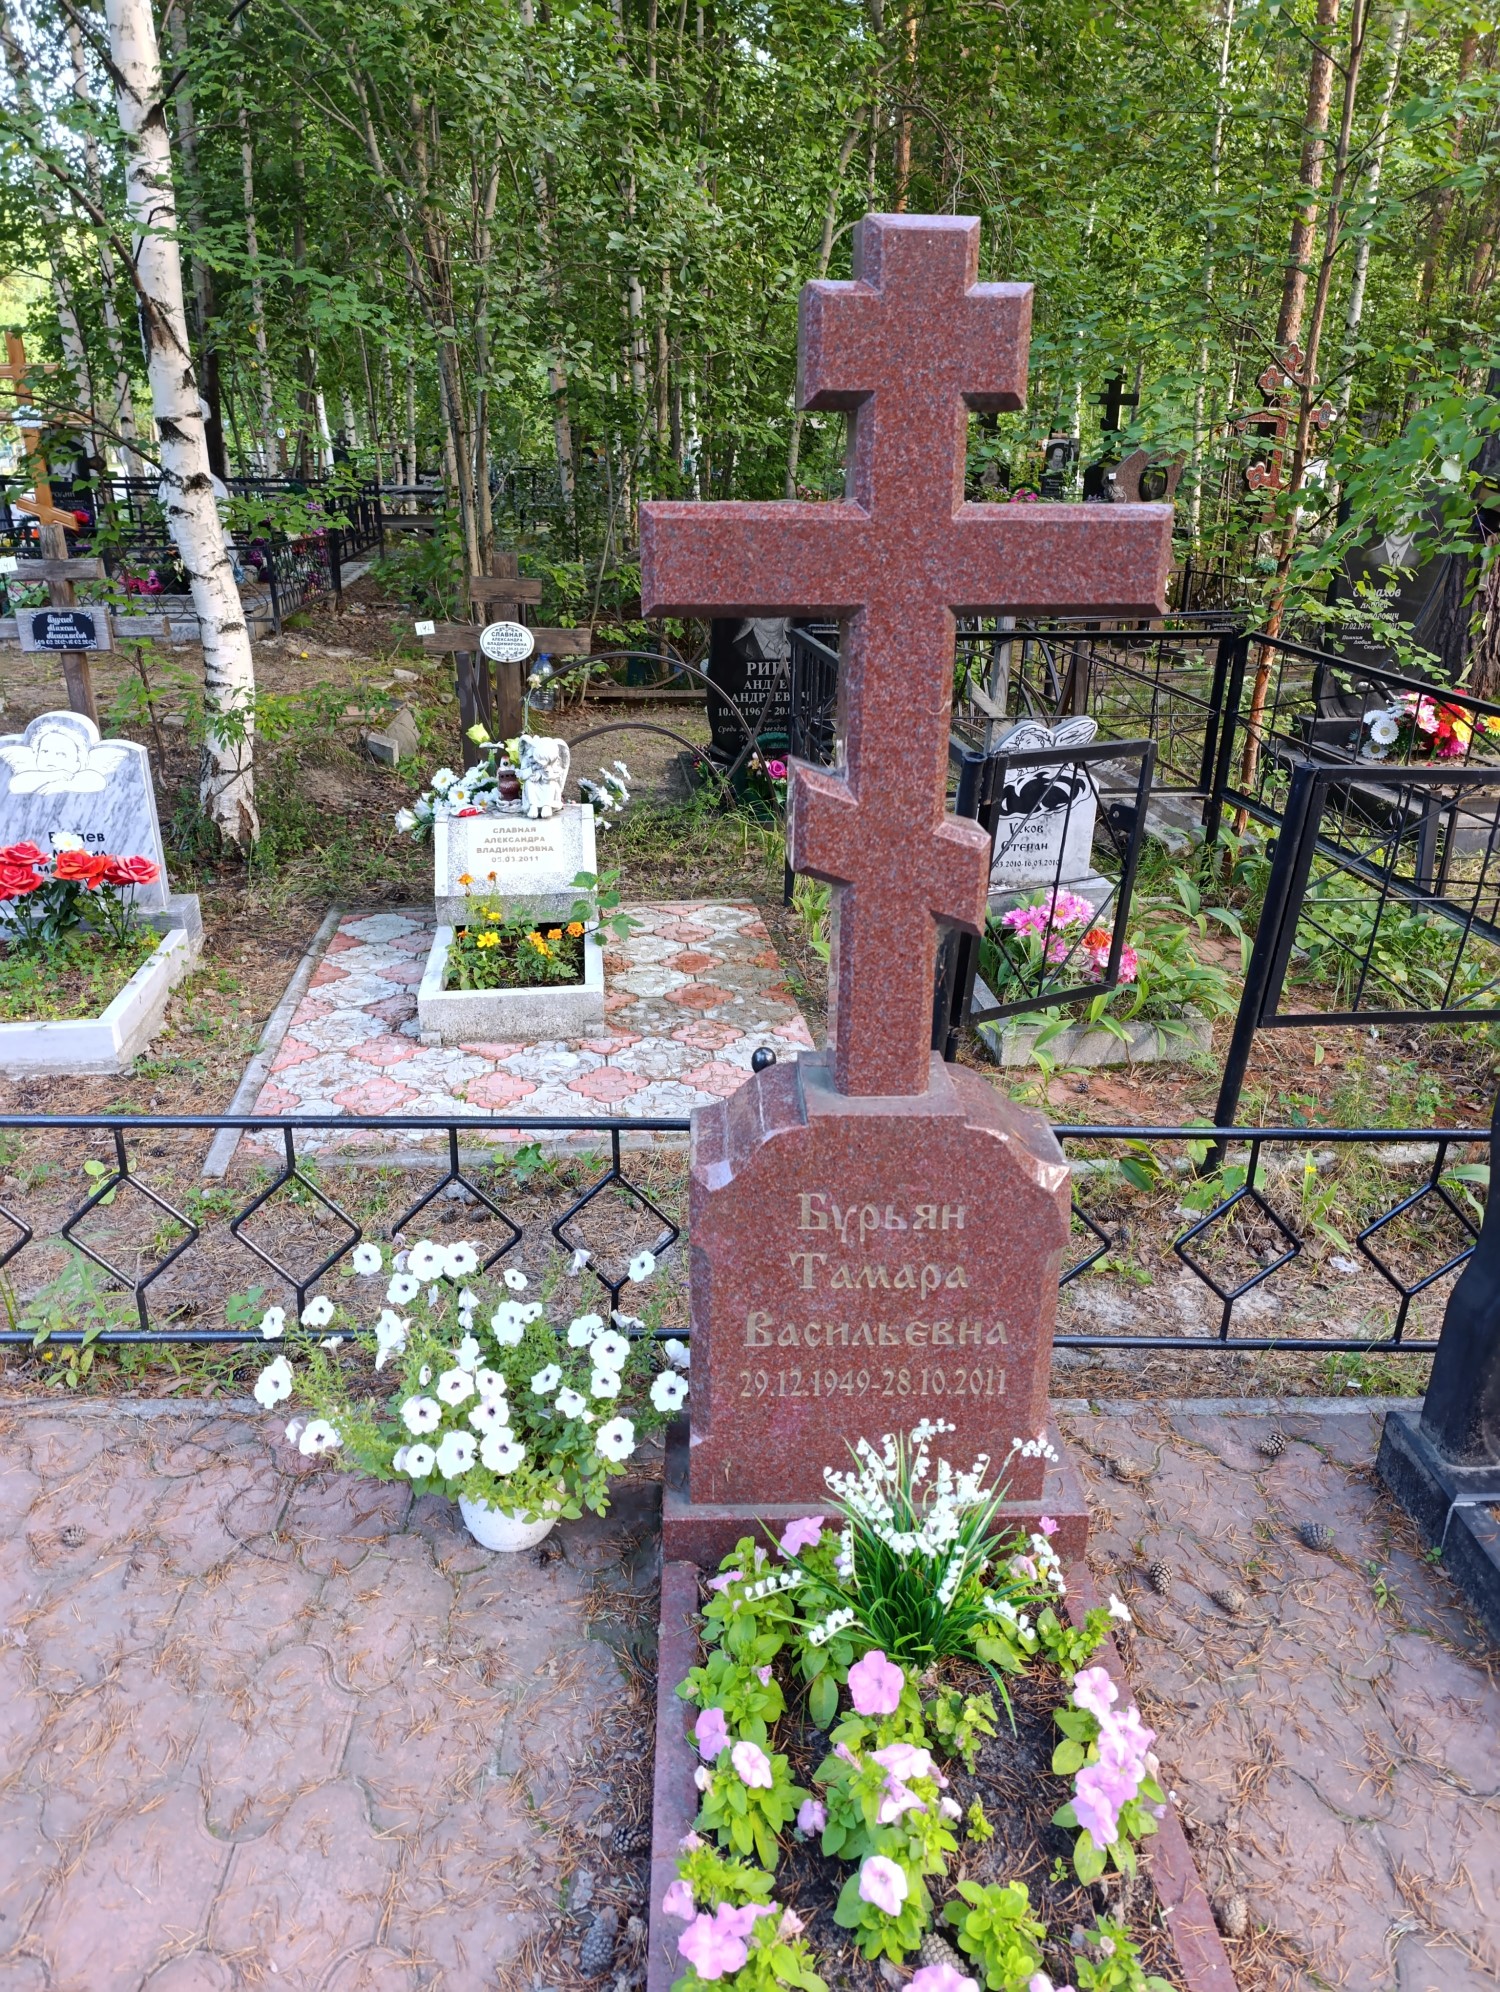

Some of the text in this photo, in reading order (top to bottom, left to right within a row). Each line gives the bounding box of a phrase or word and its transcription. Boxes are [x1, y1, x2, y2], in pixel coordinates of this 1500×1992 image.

[484, 836, 546, 844] АЛЕКСАНДРА
[492, 826, 537, 834] СЛАВНАЯ
[476, 845, 554, 854] ВЛАДИМИРОВНА
[796, 1192, 968, 1244] Бурьян
[788, 1251, 970, 1301] Тамара
[742, 1309, 1010, 1348] Васильевна
